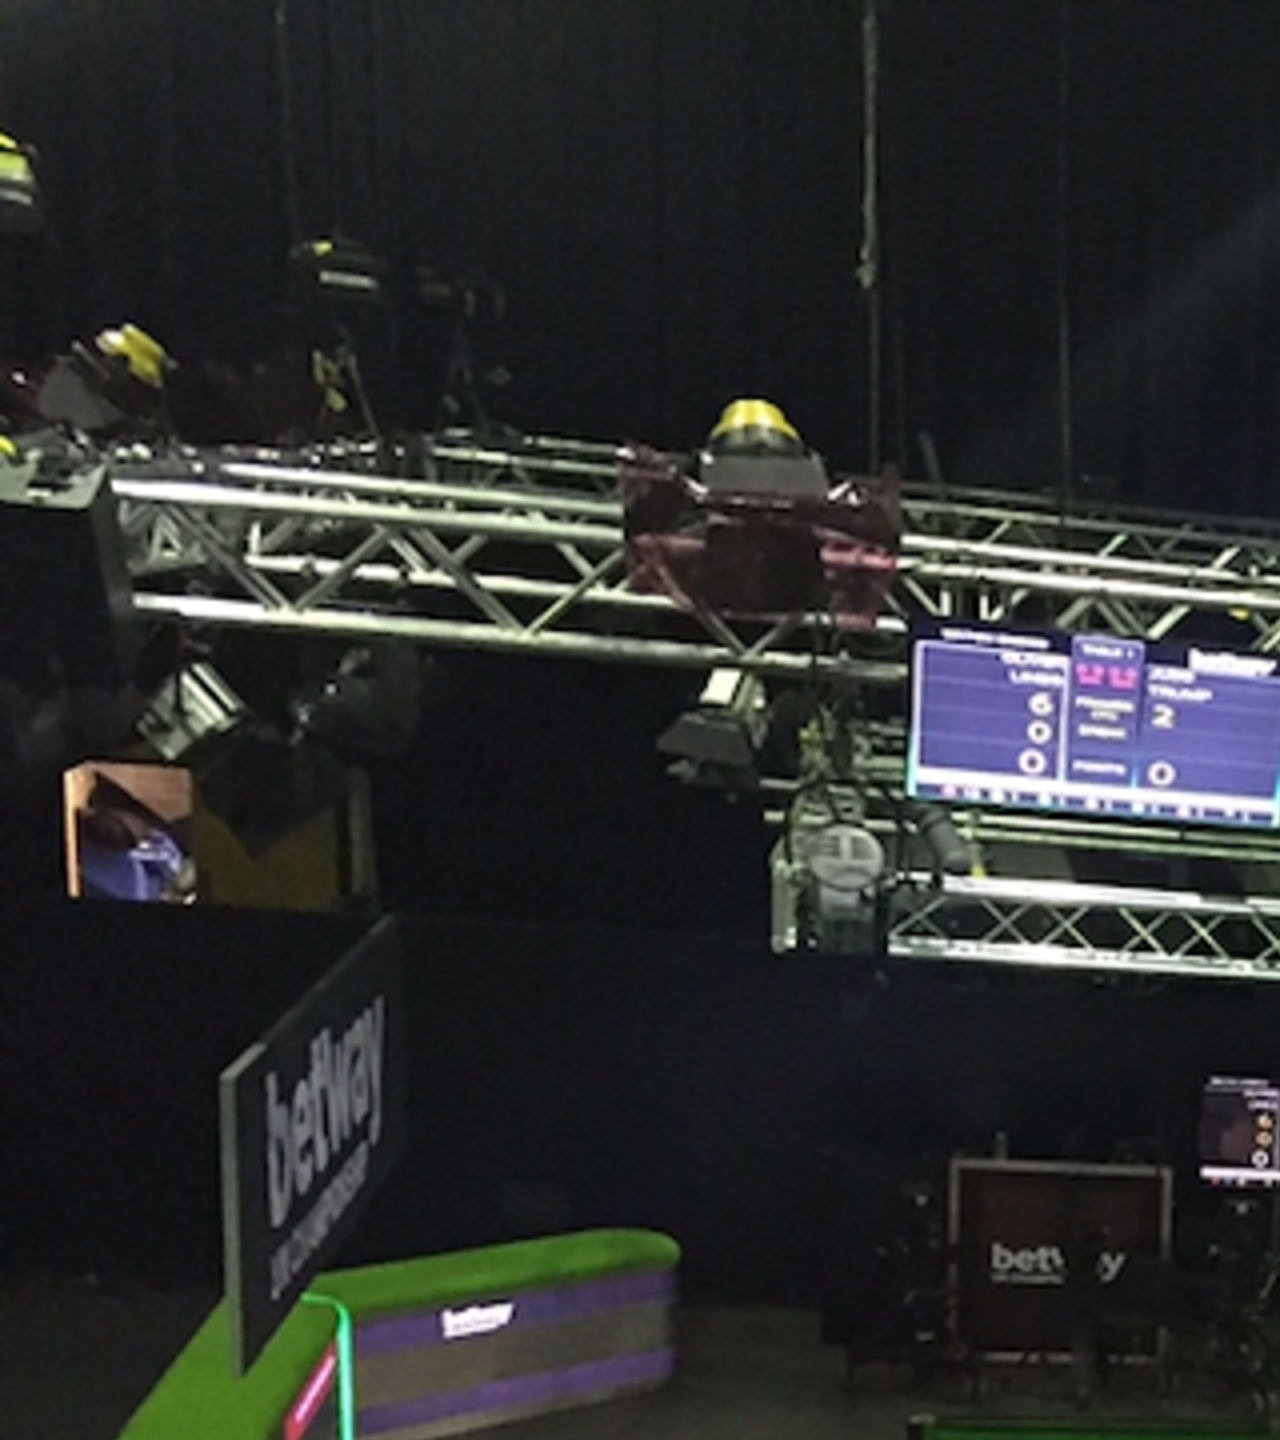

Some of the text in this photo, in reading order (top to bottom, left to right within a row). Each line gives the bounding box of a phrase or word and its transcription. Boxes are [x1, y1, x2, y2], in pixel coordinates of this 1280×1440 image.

[1028, 691, 1054, 716] 6
[1151, 704, 1175, 729] 2
[1026, 720, 1052, 745] 0
[1018, 748, 1046, 775] 0
[1148, 760, 1176, 787] 0
[264, 995, 384, 1228] betway
